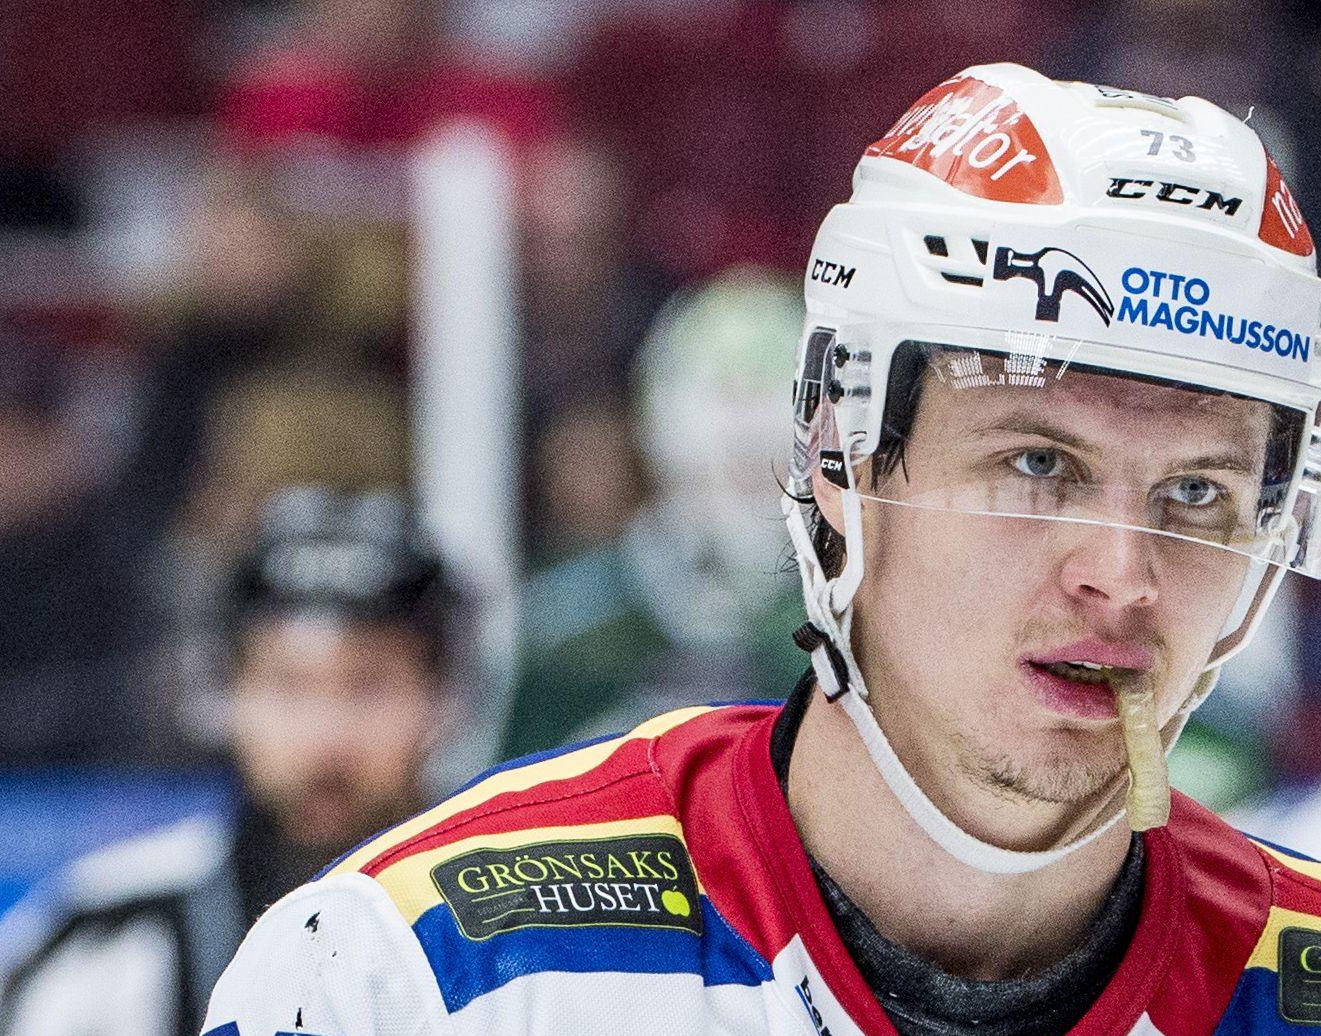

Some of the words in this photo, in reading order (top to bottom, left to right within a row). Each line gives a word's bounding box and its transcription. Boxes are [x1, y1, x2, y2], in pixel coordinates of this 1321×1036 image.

[1140, 129, 1197, 162] 73
[1106, 177, 1244, 216] CCM
[811, 258, 856, 289] CCM
[1120, 267, 1210, 306] OTTO
[1117, 296, 1311, 362] MAGNUSSON
[821, 458, 843, 471] CCM
[457, 850, 678, 893] GRÖNSAKS
[531, 883, 661, 913] HUSET
